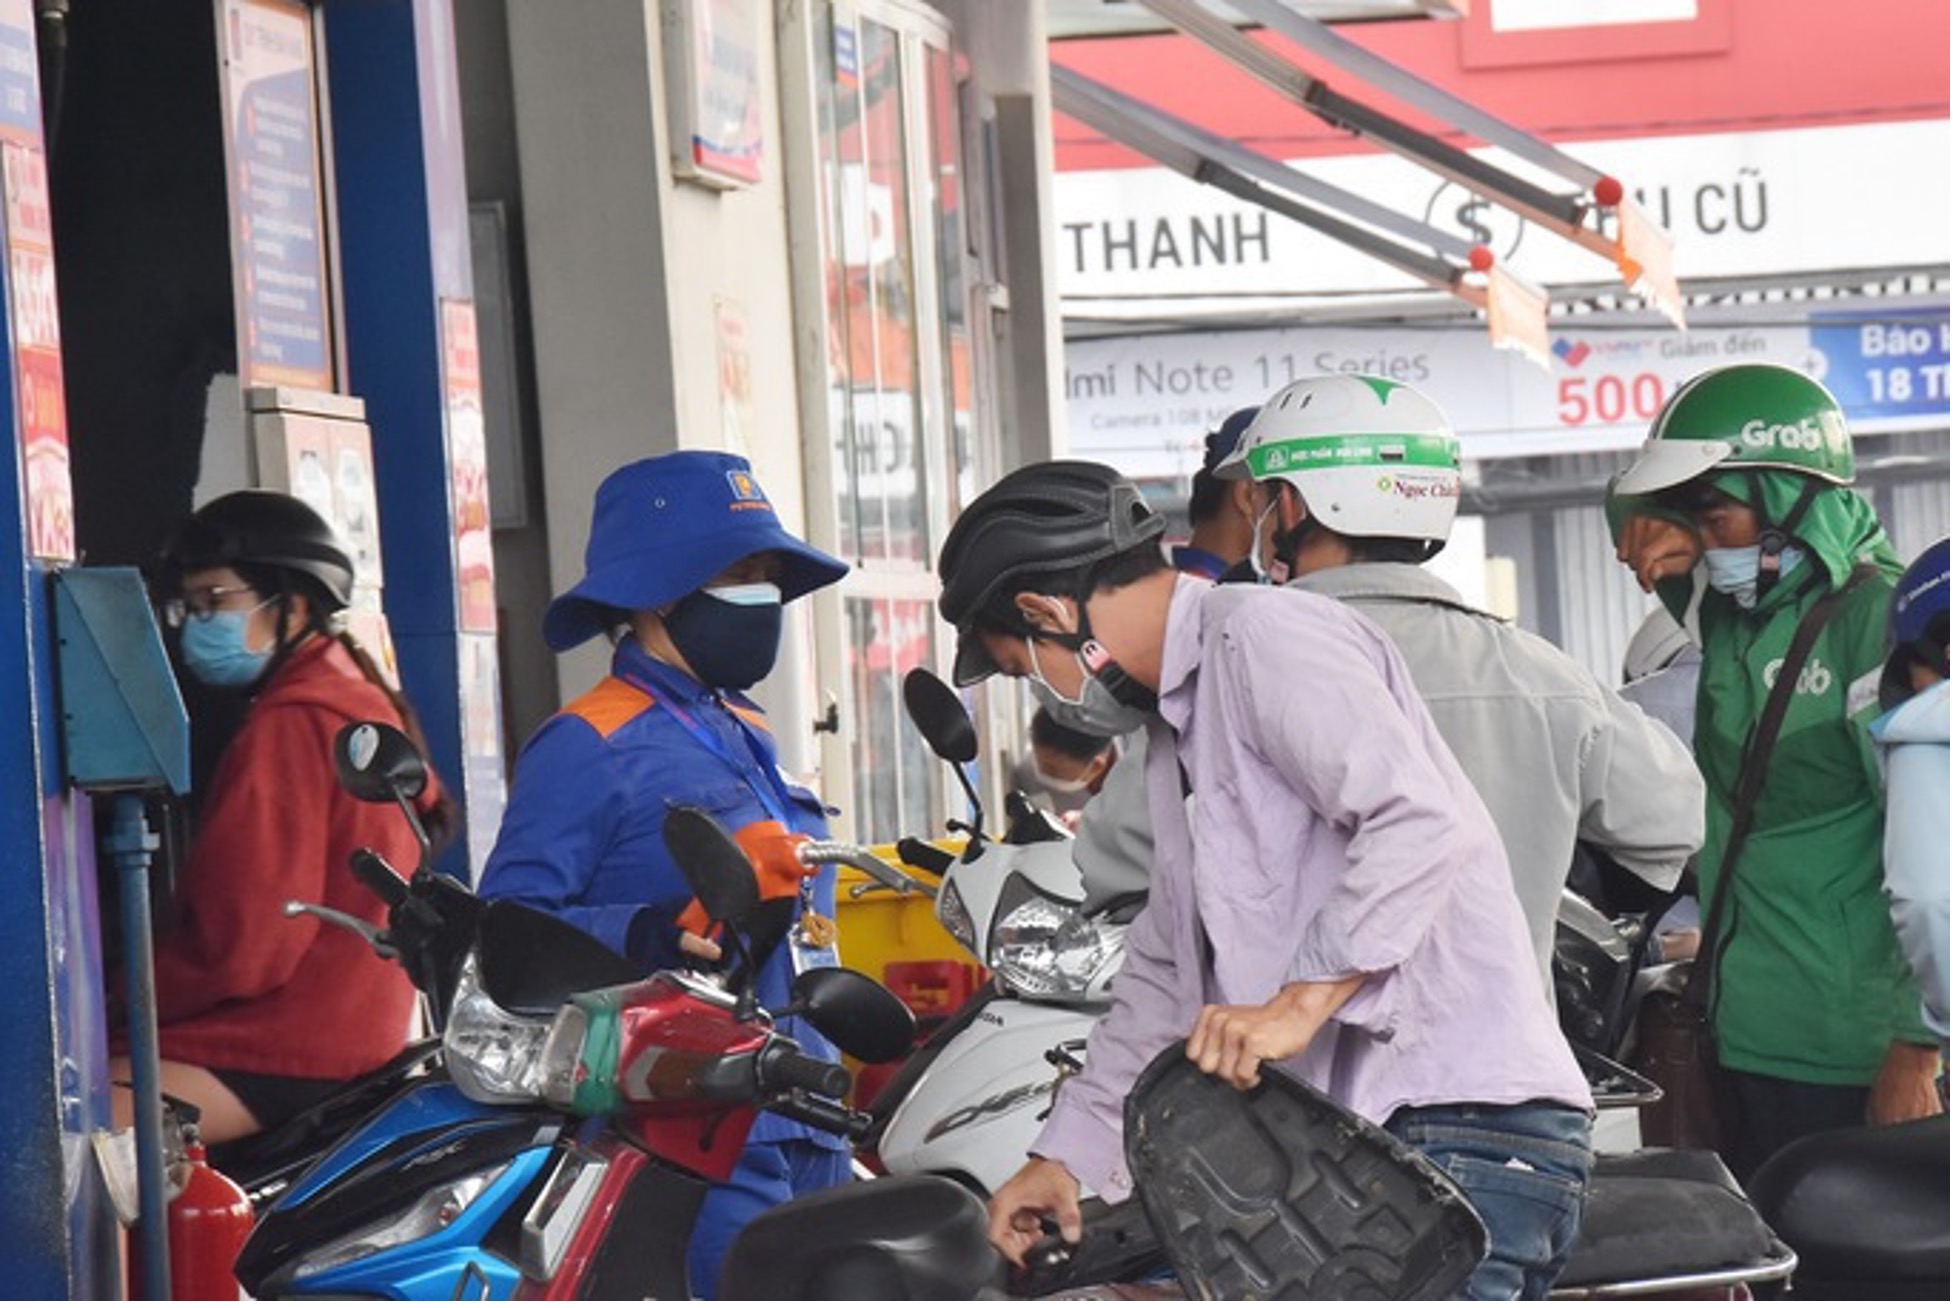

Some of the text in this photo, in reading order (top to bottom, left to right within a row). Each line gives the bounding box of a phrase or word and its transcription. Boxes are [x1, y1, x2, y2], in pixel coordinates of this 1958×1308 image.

[1694, 168, 1768, 235] CŨ
[1062, 212, 1270, 272] THANH
[1134, 360, 1235, 396] Note
[1254, 355, 1295, 389] 11
[1866, 367, 1913, 402] 18
[1558, 373, 1664, 426] 500
[1741, 419, 1820, 451] Grab
